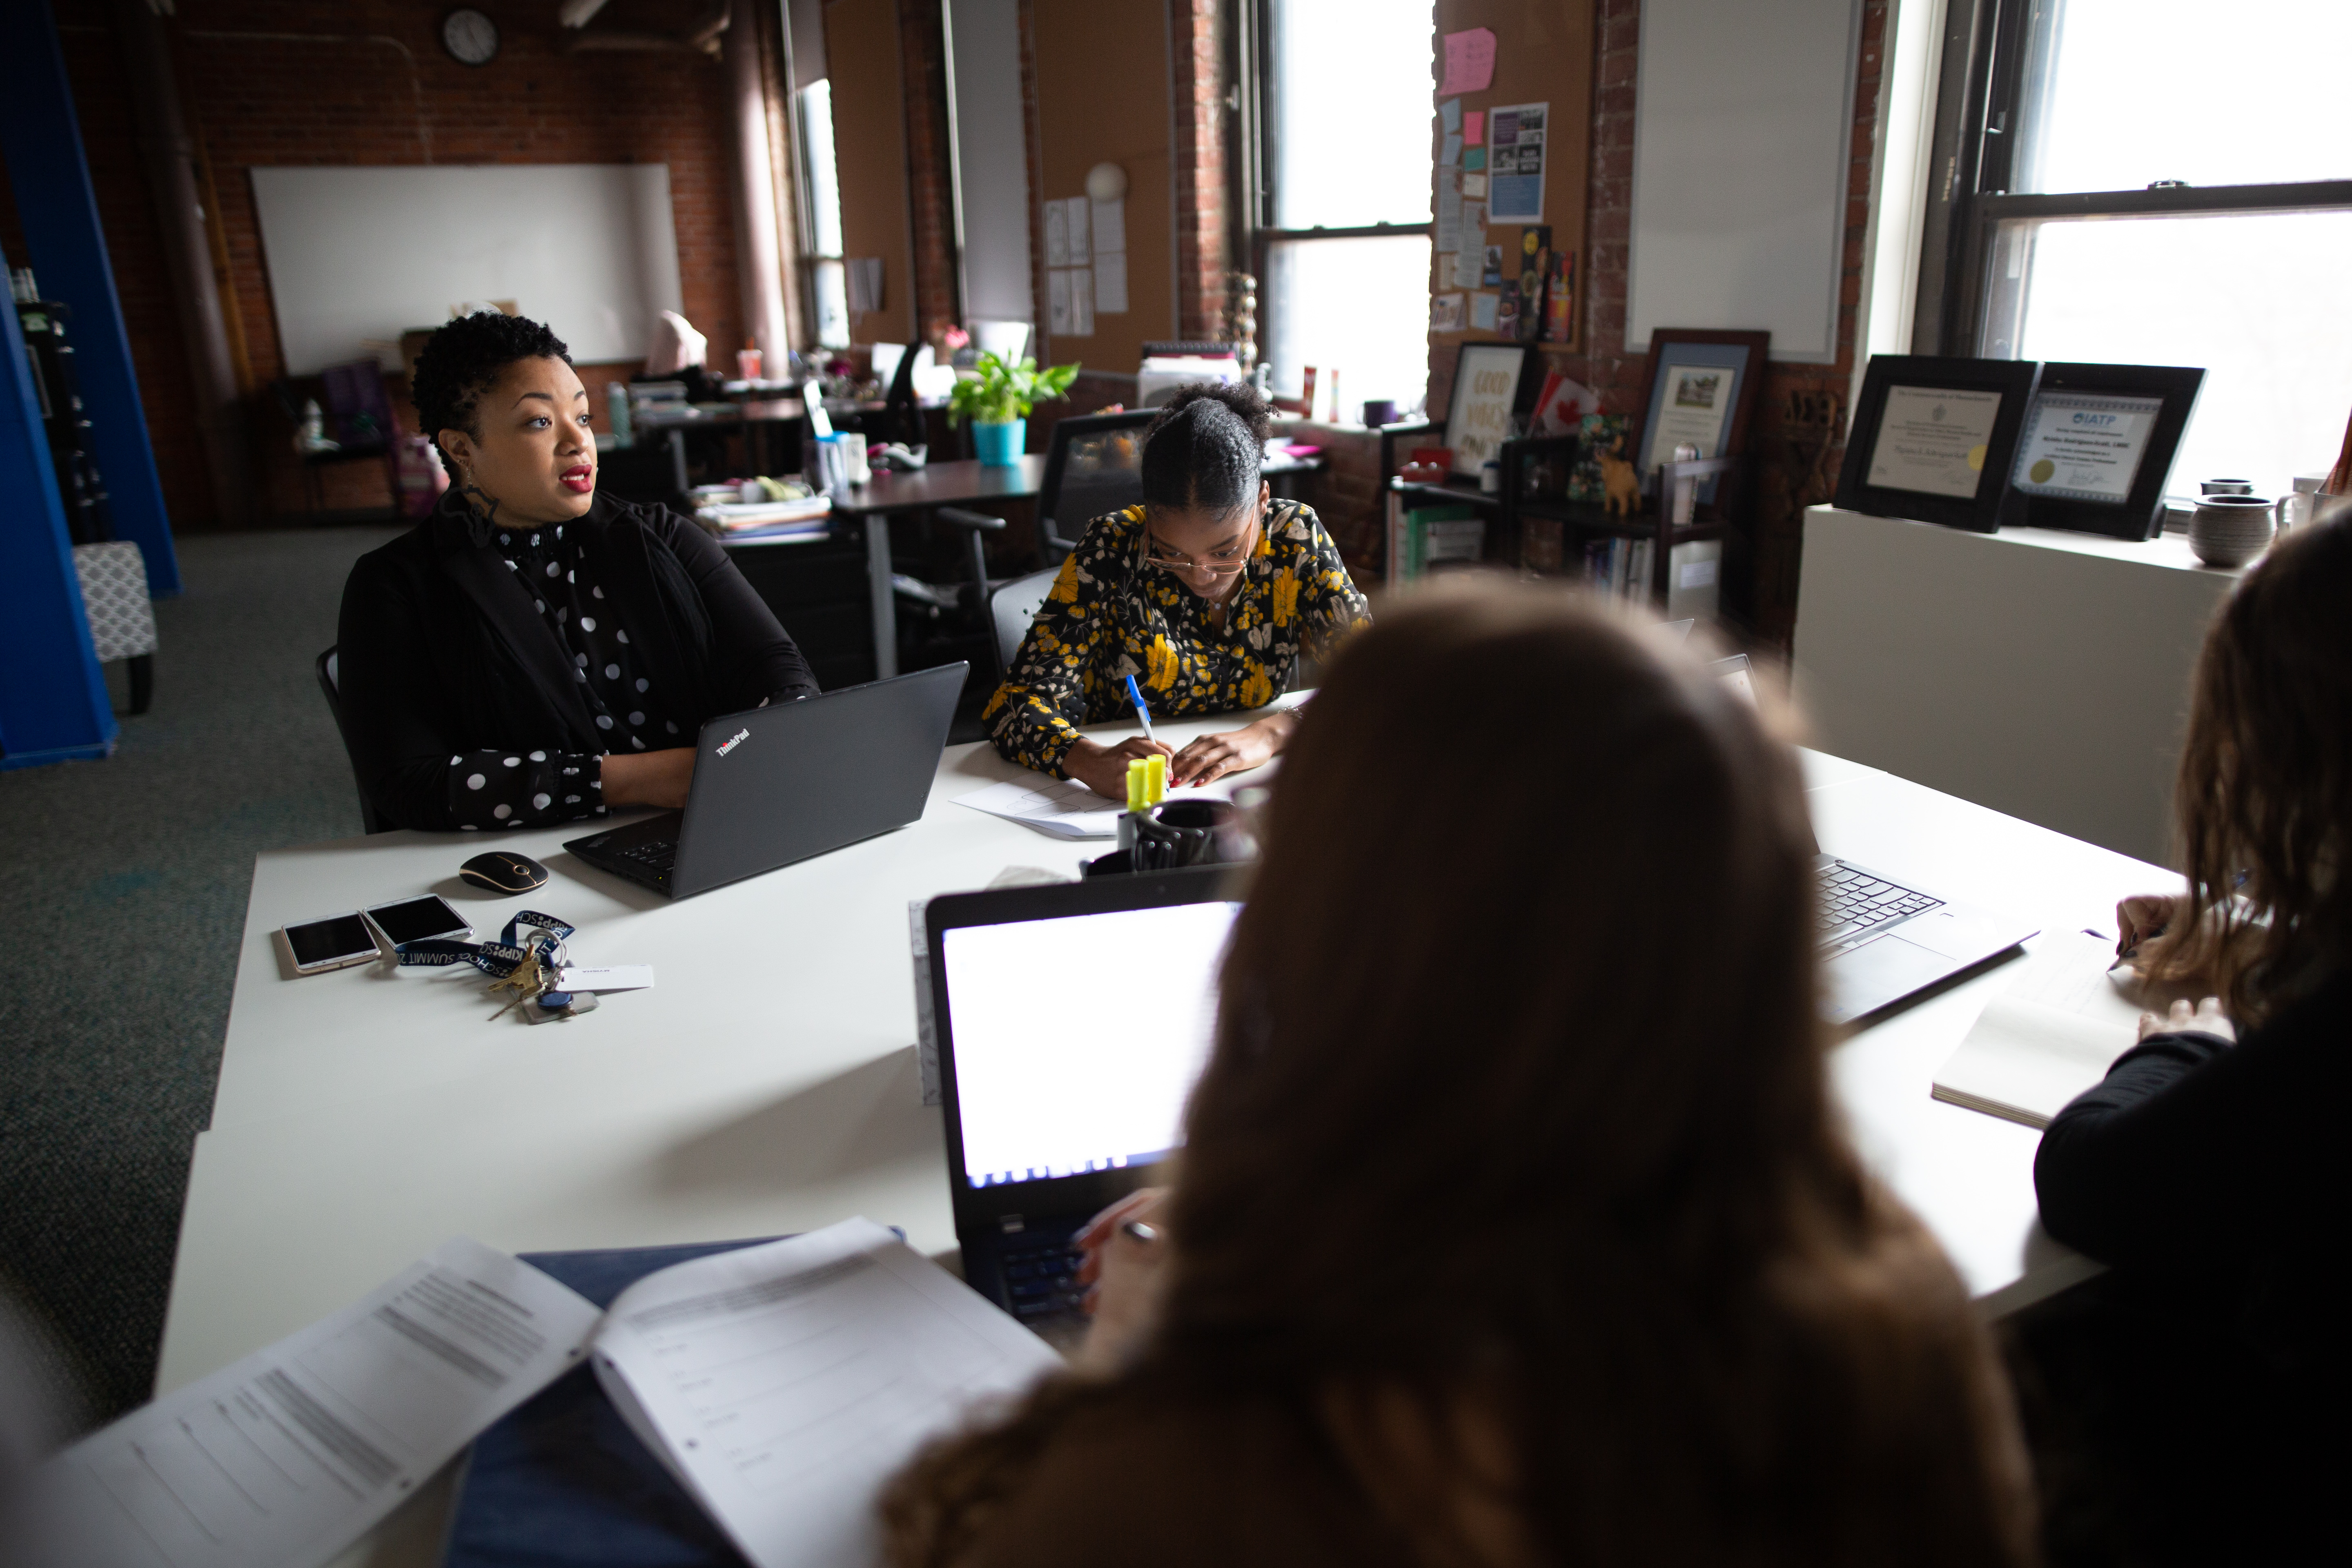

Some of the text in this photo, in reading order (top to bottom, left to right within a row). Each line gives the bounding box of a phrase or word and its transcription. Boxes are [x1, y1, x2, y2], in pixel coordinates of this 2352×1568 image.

[1473, 370, 1511, 396] GOOD
[2083, 413, 2116, 425] IATP
[715, 728, 750, 757] ThinkPad
[409, 953, 454, 964] SUMMIT
